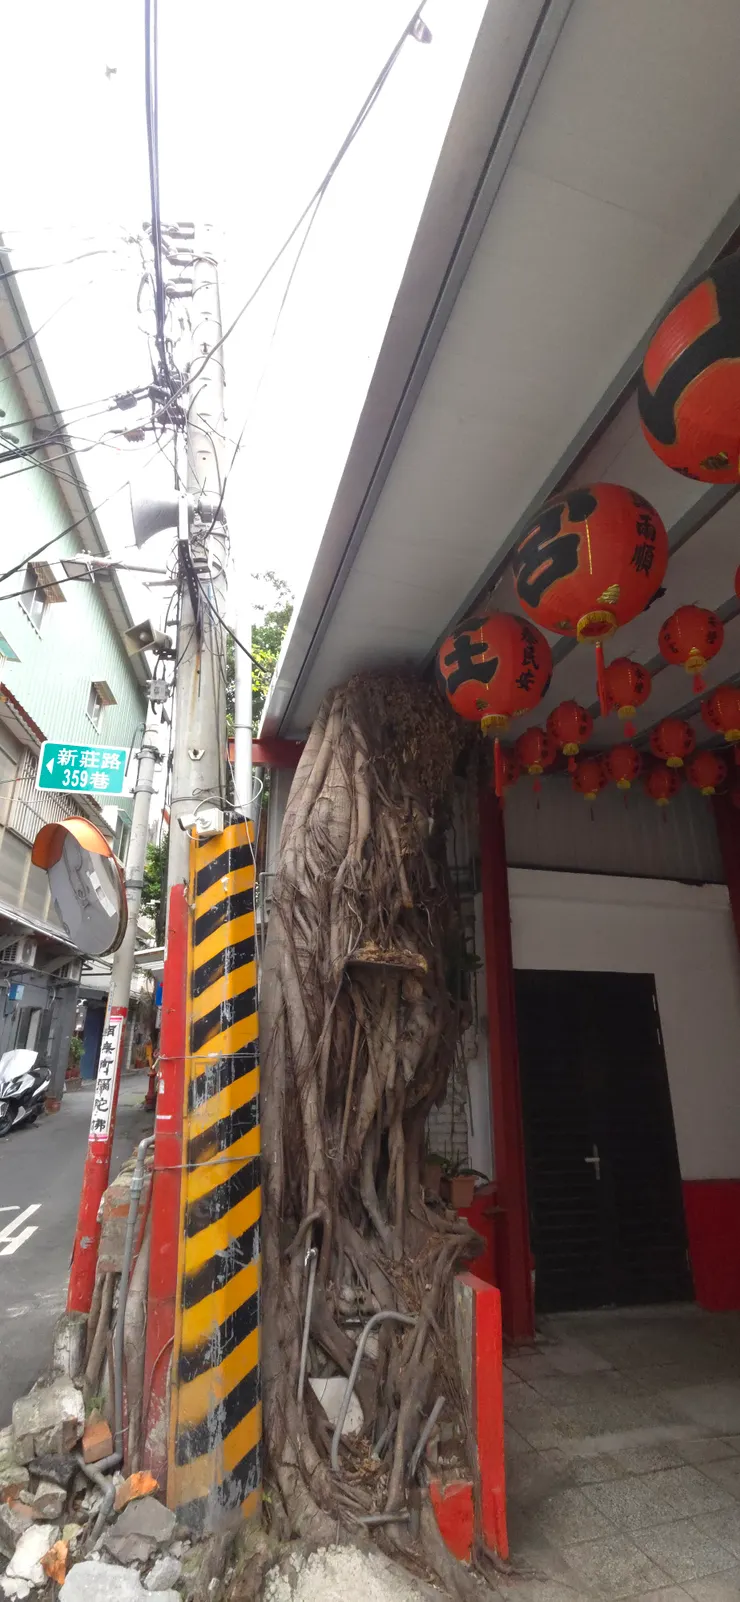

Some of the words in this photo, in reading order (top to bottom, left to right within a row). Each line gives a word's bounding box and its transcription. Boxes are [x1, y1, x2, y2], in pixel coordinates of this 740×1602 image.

[512, 616, 540, 691] 泰民安
[57, 748, 121, 770] 新莊路
[62, 769, 110, 790] 359巷
